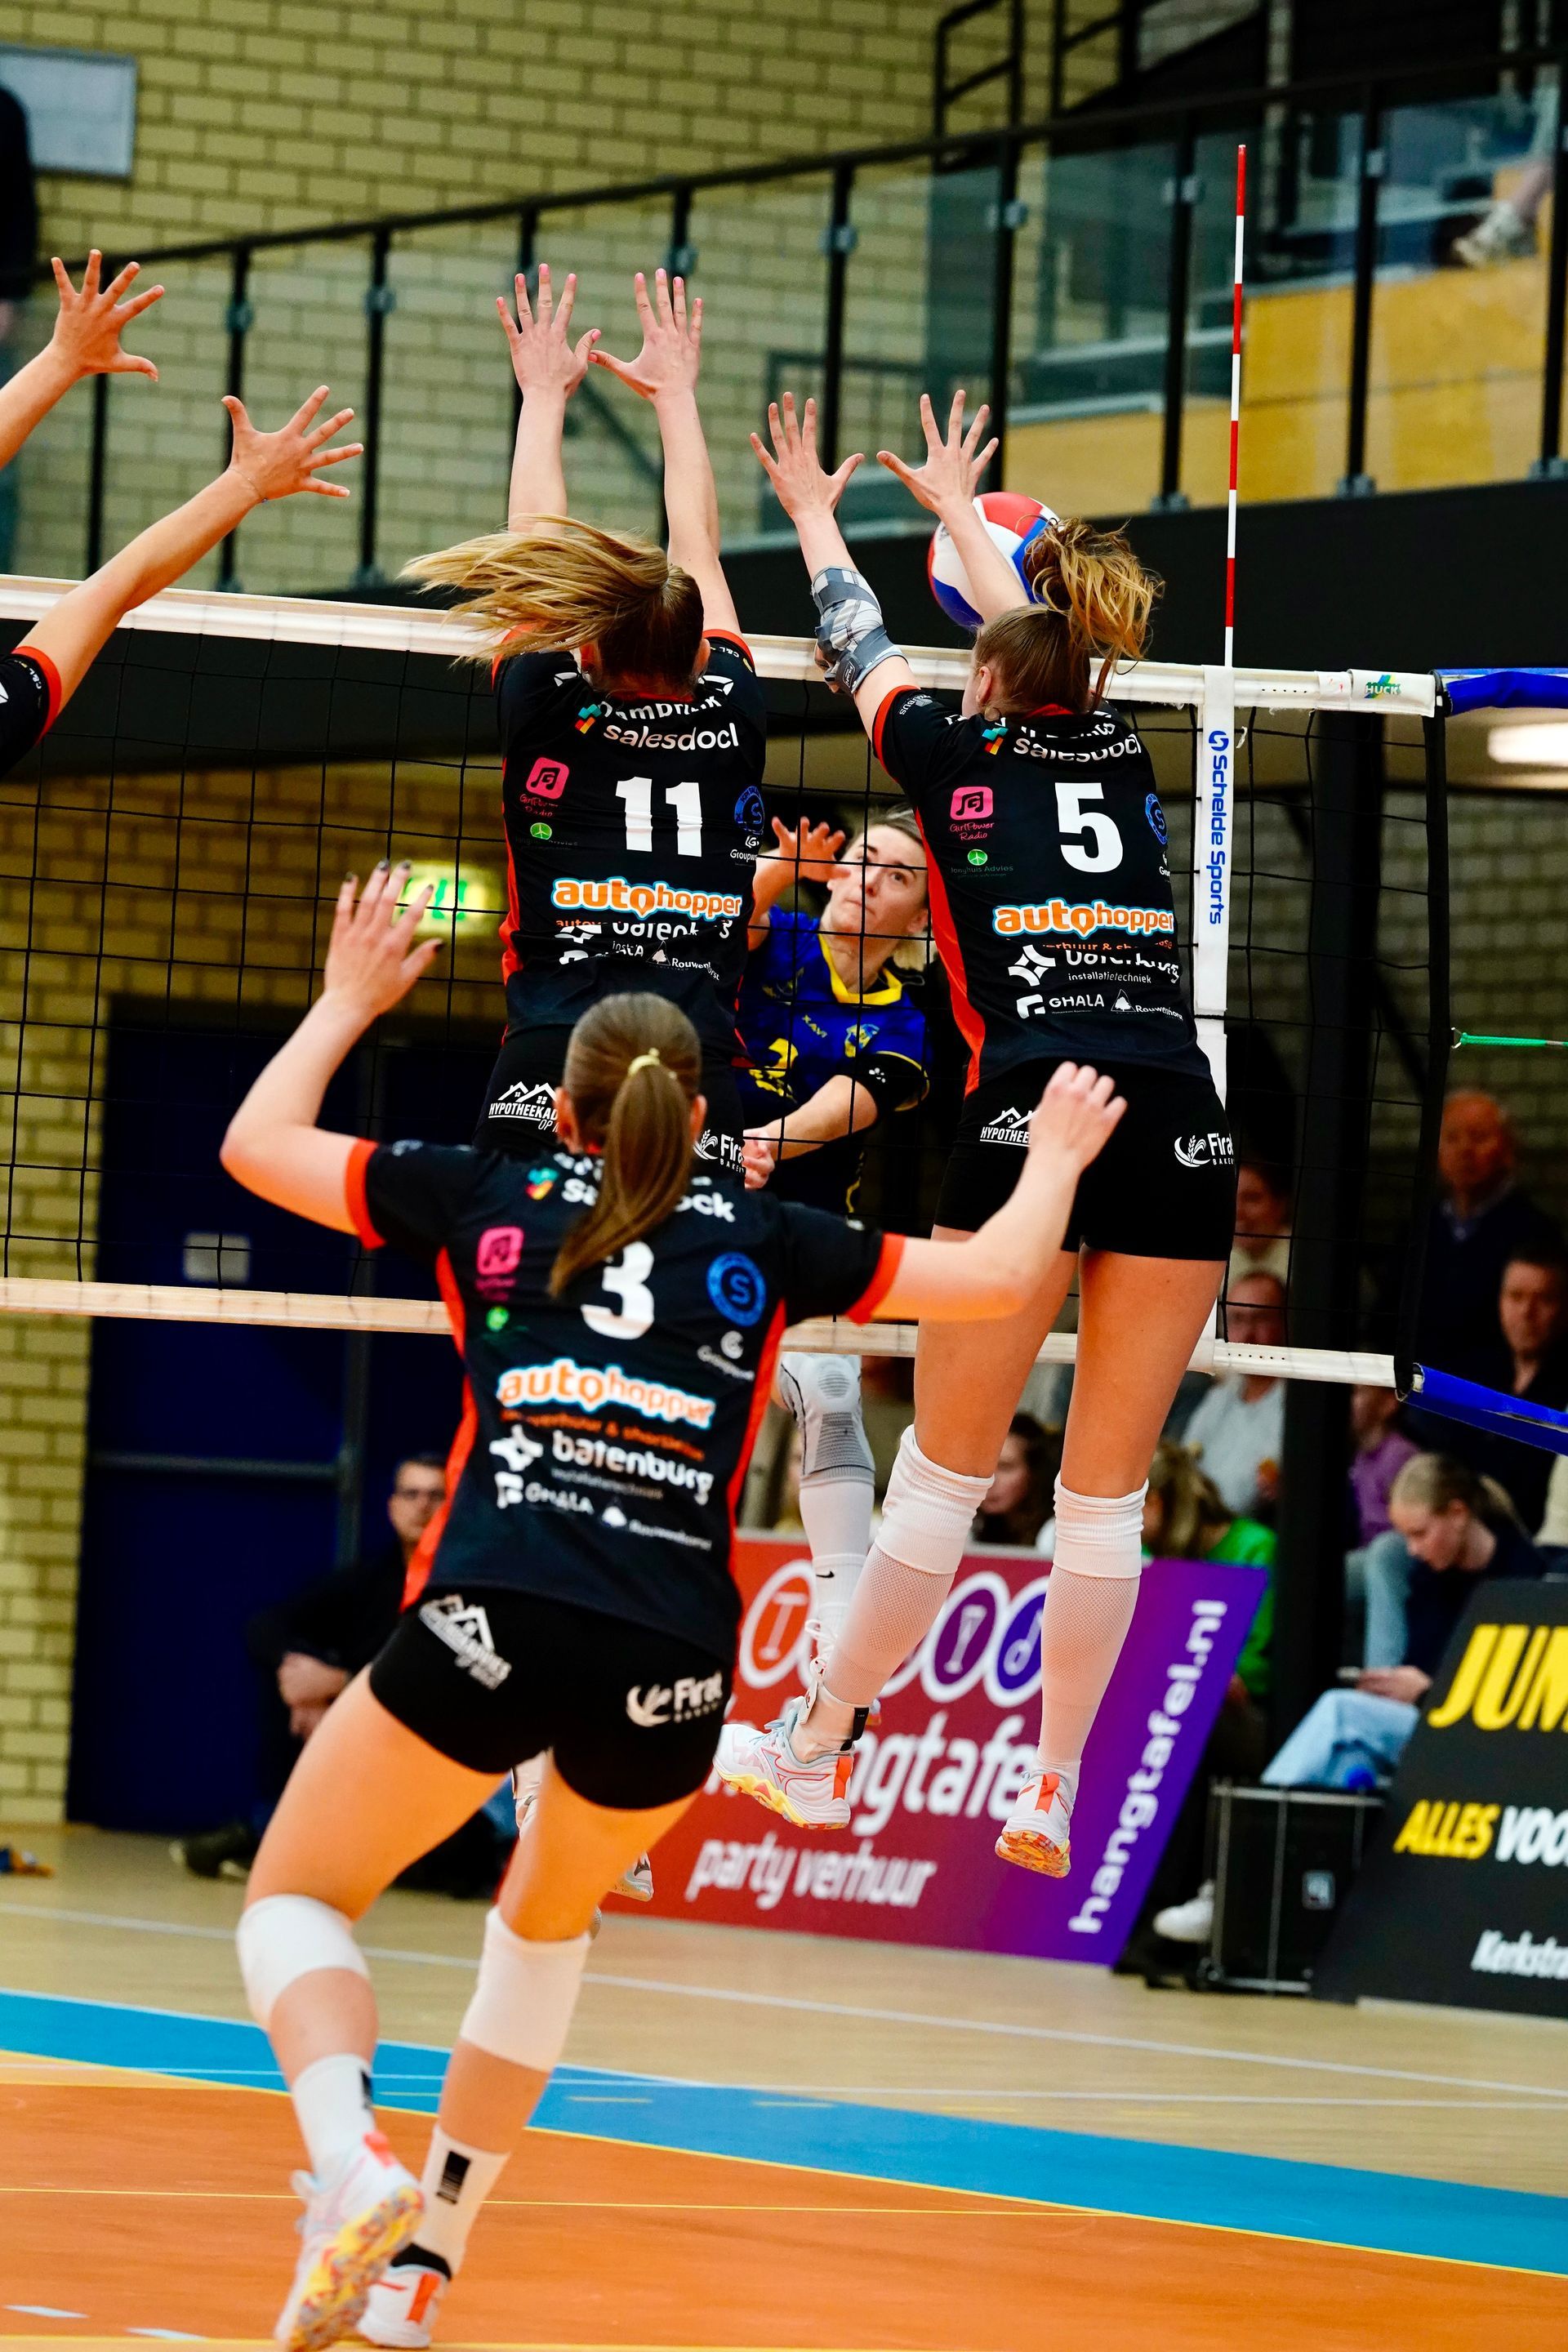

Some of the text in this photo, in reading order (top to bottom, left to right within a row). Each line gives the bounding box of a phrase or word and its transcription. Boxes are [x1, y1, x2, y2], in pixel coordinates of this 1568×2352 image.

[615, 777, 703, 858] 11
[959, 831, 988, 841] Radio
[1054, 782, 1124, 874] 5
[1206, 754, 1228, 924] Schelde Sports
[552, 876, 742, 920] autohopper
[994, 898, 1174, 938] autohopper
[1049, 994, 1105, 1008] GHALA
[1067, 971, 1152, 984] installatietechniek
[720, 1134, 743, 1165] Fira
[980, 1126, 1030, 1144] HYPOTHEE
[581, 1241, 654, 1340] 3
[496, 1357, 716, 1428] autohopper
[1067, 1599, 1228, 1935] hangtafel.nl
[1393, 1798, 1568, 1867] ALLES VOO
[684, 1831, 938, 1911] party verhuur
